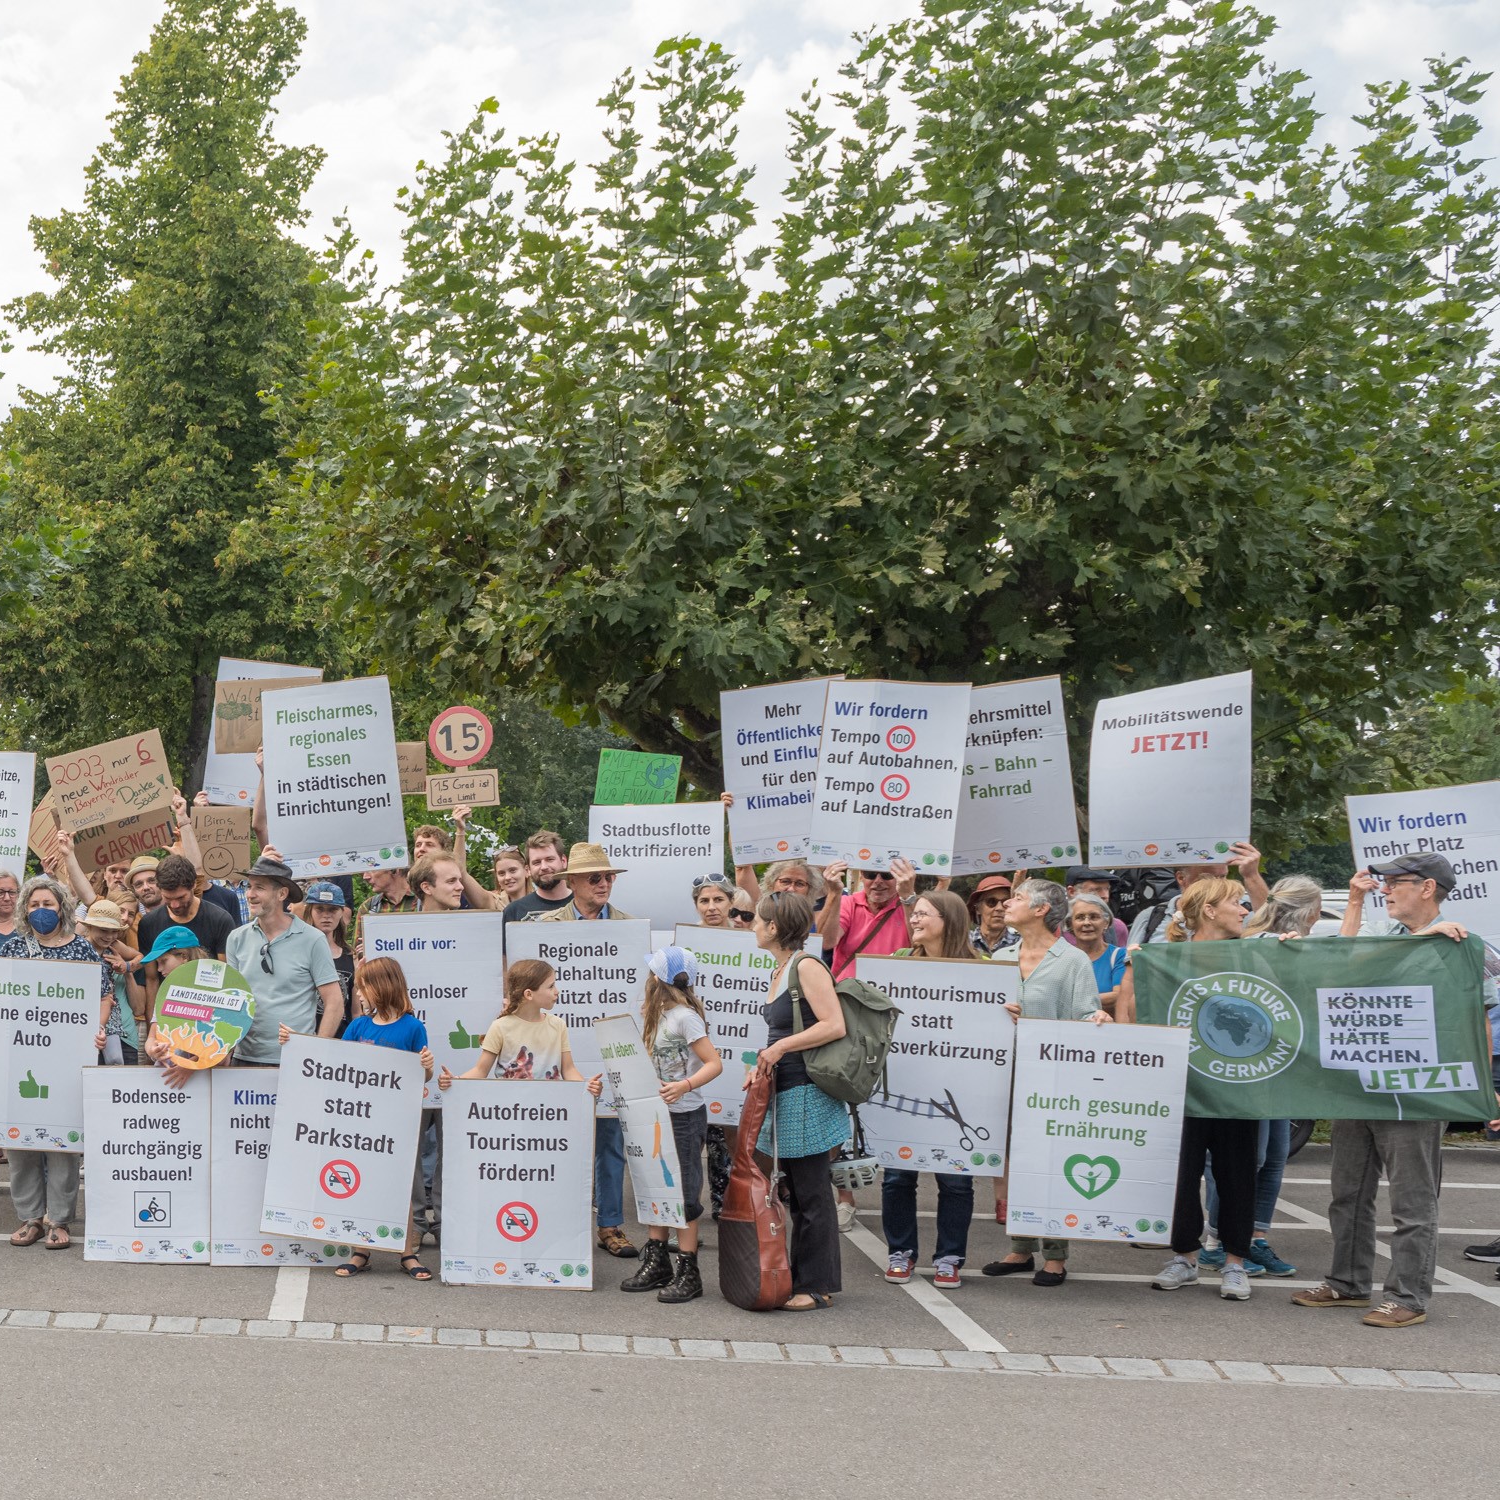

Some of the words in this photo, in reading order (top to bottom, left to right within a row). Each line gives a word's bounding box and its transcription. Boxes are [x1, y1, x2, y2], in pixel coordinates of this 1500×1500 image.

[276, 703, 378, 726] Fleischarmes,
[1101, 702, 1244, 731] Mobilitätswende
[289, 726, 367, 750] regionales
[830, 728, 881, 747] Tempo
[890, 733, 911, 746] 100
[1130, 730, 1209, 754] JETZT!
[51, 754, 106, 786] 2023
[111, 754, 132, 769] nur
[136, 738, 151, 761] 6
[307, 753, 351, 769] Essen
[858, 751, 958, 772] Autobahnen,
[994, 755, 1037, 773] Bahn
[297, 771, 387, 793] städtischen
[452, 778, 476, 791] Grad
[478, 779, 491, 789] ist
[887, 781, 903, 794] 80
[969, 779, 1032, 800] Fahrrad
[60, 784, 90, 803] neue
[63, 805, 75, 815] in
[74, 787, 116, 814] Bayern?
[115, 780, 156, 805] Danke
[133, 787, 162, 811] Söder
[436, 794, 453, 805] das
[456, 792, 477, 802] Limit
[276, 792, 392, 818] Einrichtungen!
[852, 799, 953, 820] Landstraßen
[117, 814, 142, 830] oder
[602, 822, 711, 837] Stadtbusflotte
[94, 820, 176, 866] GARNICHT!
[1362, 840, 1411, 859] mehr
[538, 941, 618, 963] Regionale
[37, 981, 85, 1000] Leben
[170, 987, 226, 1006] LANDTAGSWAHL
[226, 997, 240, 1007] IST
[25, 1005, 88, 1027] eigenes
[163, 1003, 210, 1019] KLIMAWAHL!
[12, 1029, 52, 1048] Auto
[1039, 1043, 1096, 1064] Klima
[1103, 1050, 1164, 1068] retten
[301, 1057, 403, 1091] Stadtpark
[111, 1088, 192, 1104] Bodensee-
[1026, 1092, 1081, 1112] durch
[1086, 1099, 1171, 1118] gesunde
[230, 1113, 271, 1130] nicht
[467, 1102, 568, 1122] Autofreien
[123, 1114, 181, 1135] radweg
[1045, 1119, 1148, 1148] Ernährung
[295, 1122, 395, 1155] Parkstadt
[466, 1131, 569, 1152] Tourismus
[102, 1140, 203, 1160] durchgängig
[478, 1162, 555, 1182] fördern!
